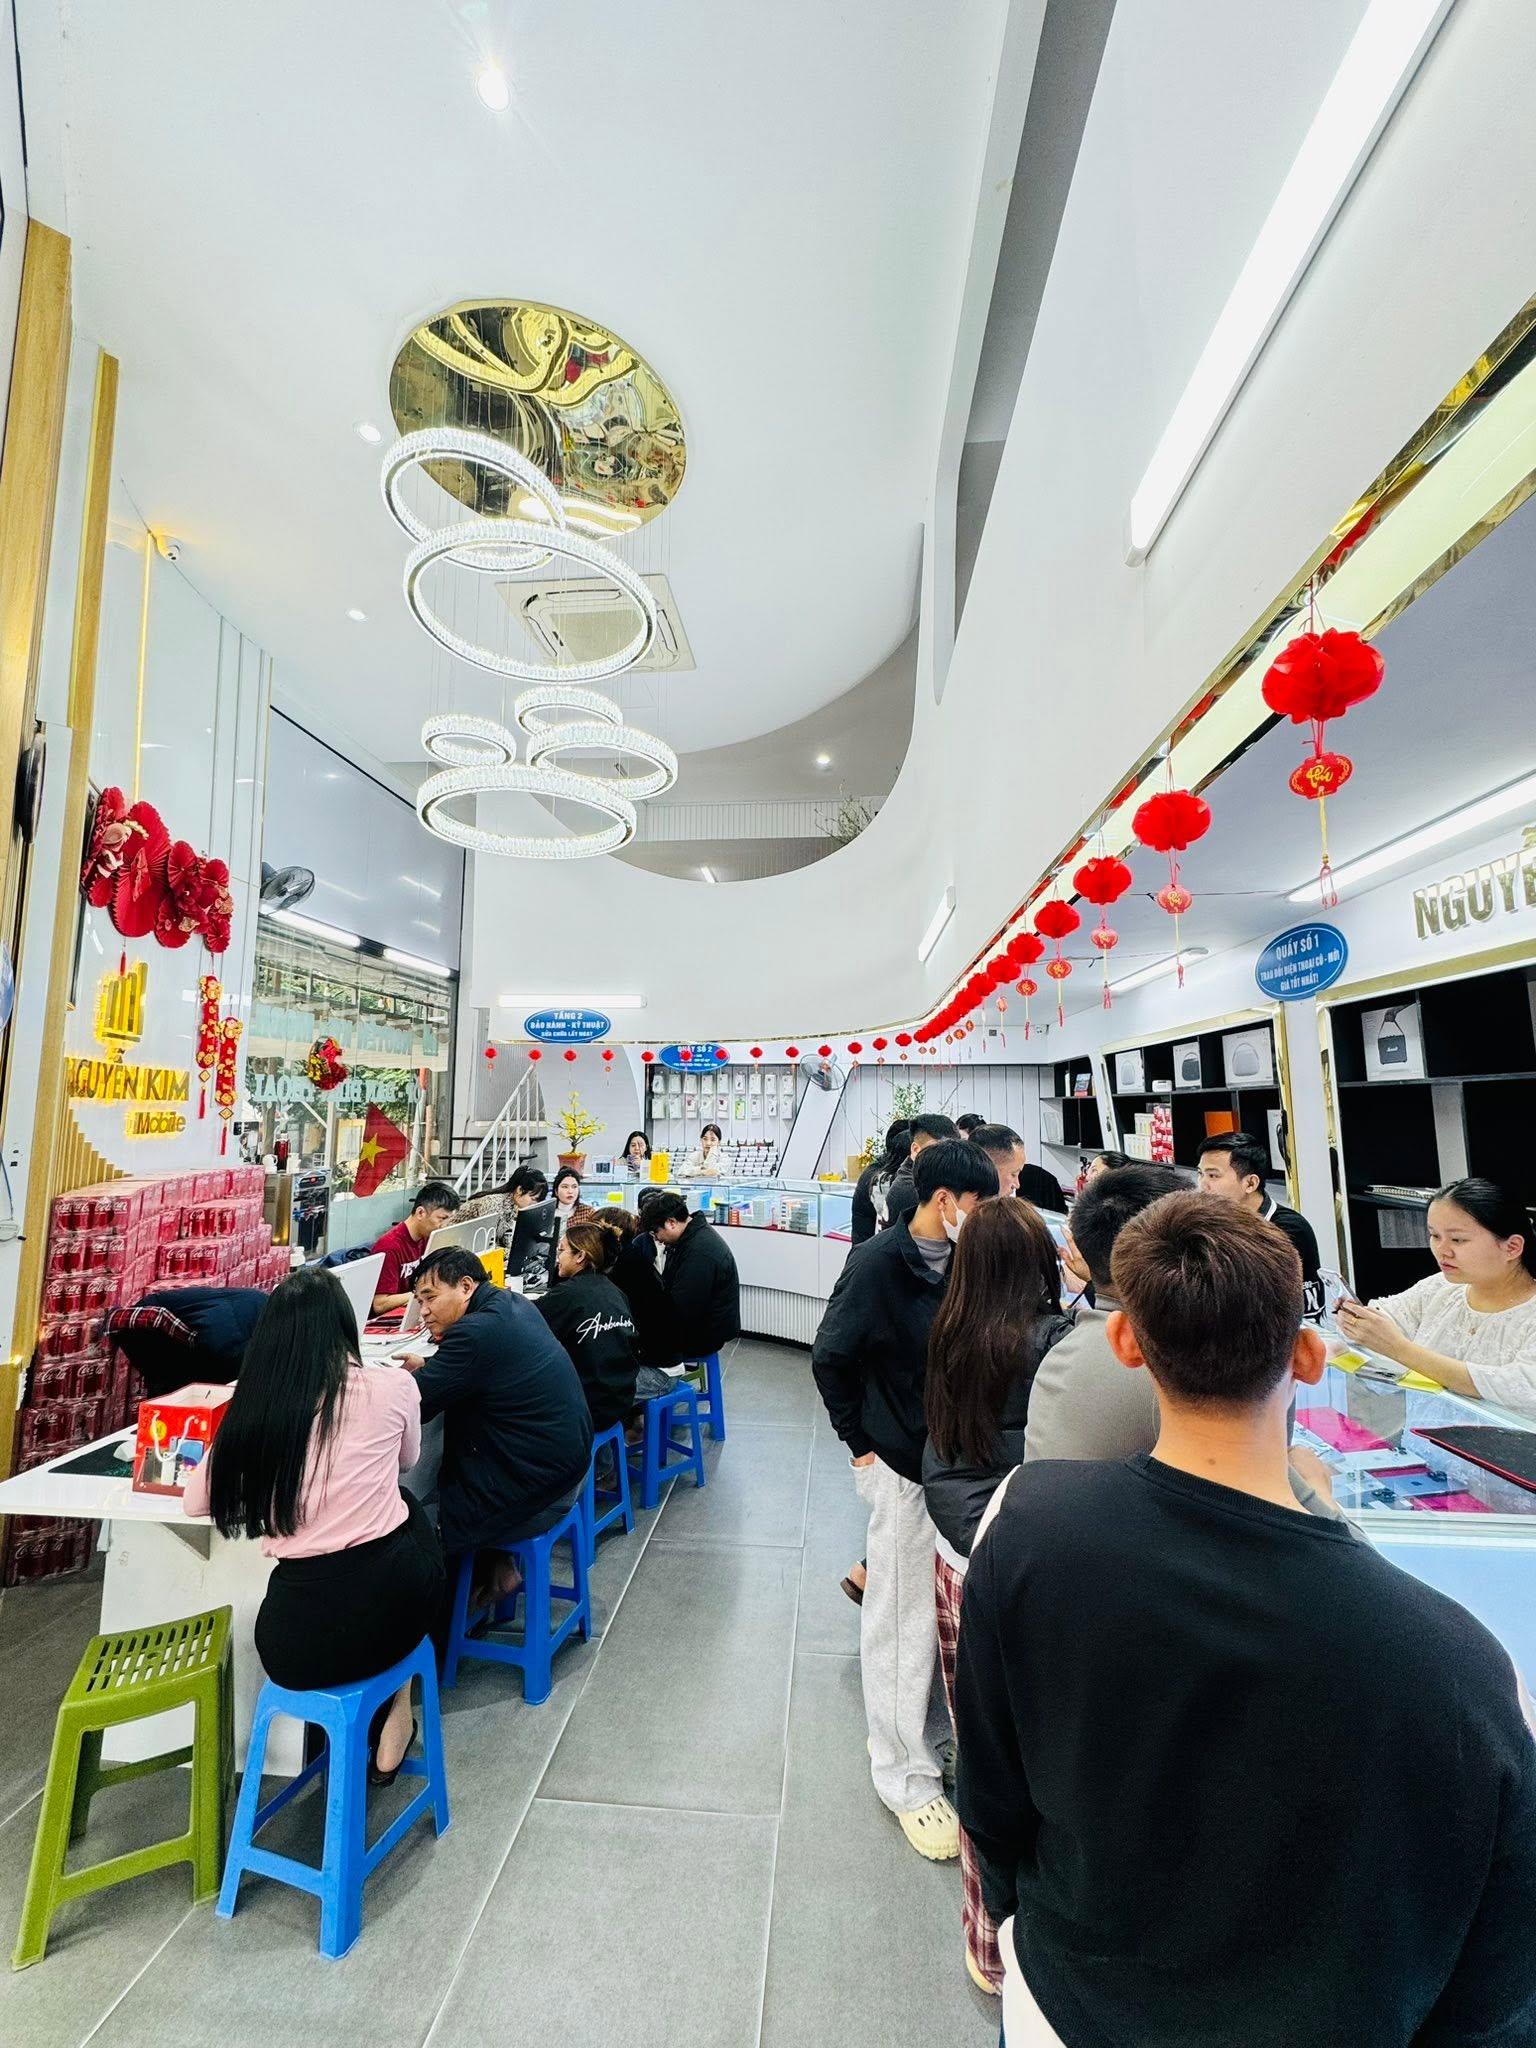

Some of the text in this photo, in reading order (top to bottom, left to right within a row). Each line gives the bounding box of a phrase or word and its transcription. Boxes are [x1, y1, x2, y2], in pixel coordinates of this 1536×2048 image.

[1300, 931, 1313, 953] SỐ
[1314, 933, 1319, 948] 1
[530, 1020, 545, 1029] BẢO
[546, 1020, 566, 1029] HÀNH
[582, 1020, 605, 1030] THUẬT
[577, 1012, 583, 1020] 2
[144, 1069, 190, 1100] KIM
[134, 1111, 187, 1134] Mobile
